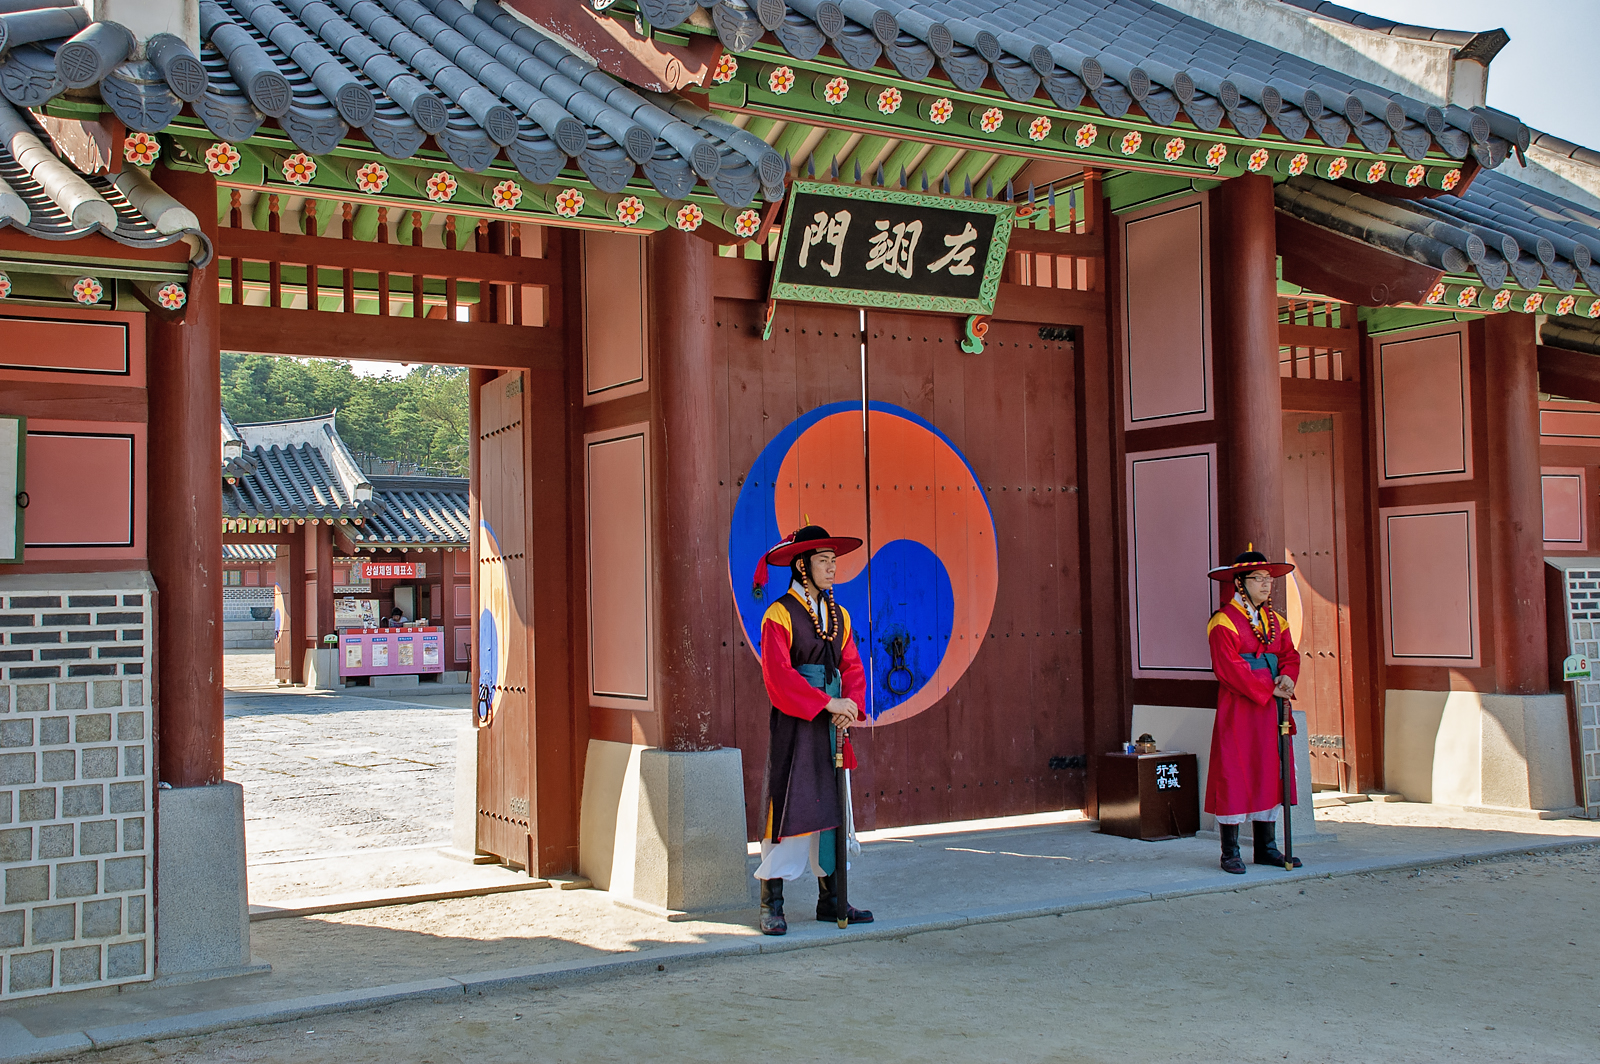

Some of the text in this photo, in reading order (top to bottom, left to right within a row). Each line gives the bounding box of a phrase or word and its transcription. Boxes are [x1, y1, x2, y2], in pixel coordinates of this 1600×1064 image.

[365, 565, 413, 576] 상설체험 매표소
[1581, 659, 1586, 669] 6
